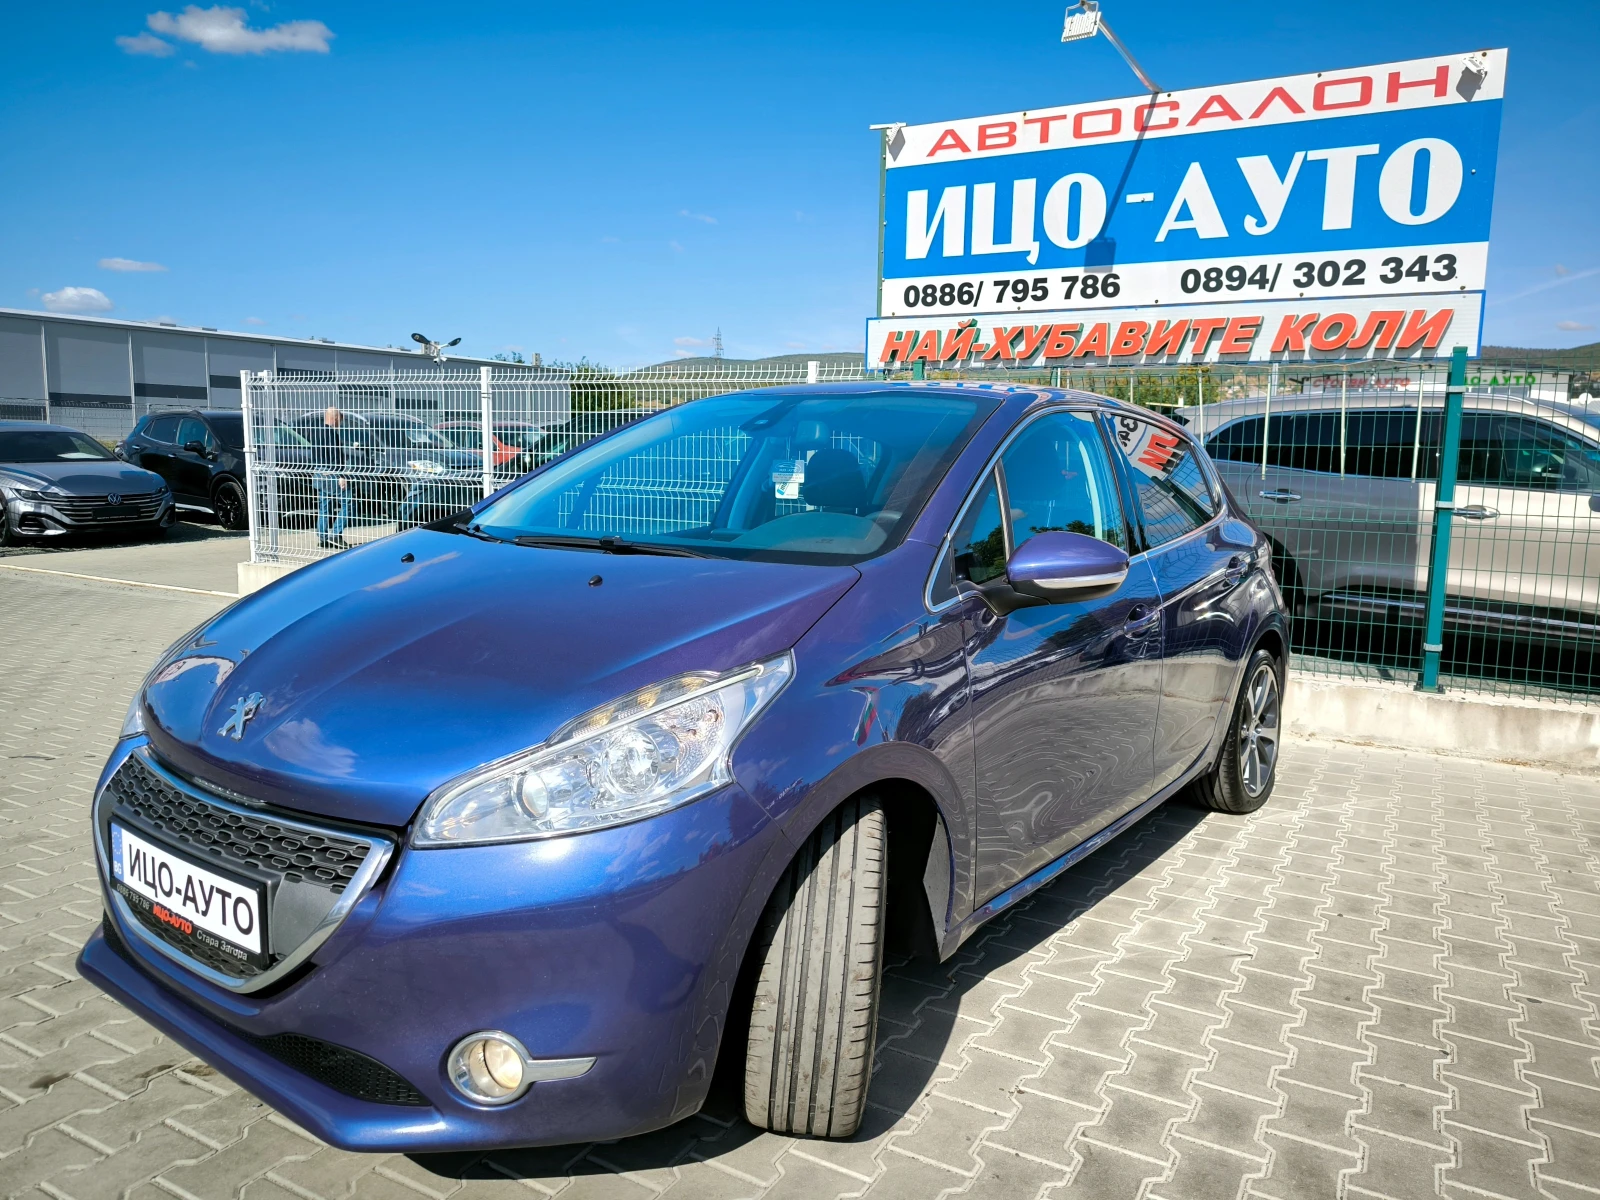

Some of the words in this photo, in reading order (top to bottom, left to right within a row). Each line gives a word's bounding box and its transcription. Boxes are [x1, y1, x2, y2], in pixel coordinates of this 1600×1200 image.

[926, 65, 1450, 157] АВТОСАЛОН
[905, 138, 1463, 265] ИЦО-АУТО
[903, 281, 983, 308] 0886/
[993, 277, 1049, 302] 795
[1061, 273, 1121, 299] 786
[1180, 263, 1282, 294] 0894/
[1292, 259, 1366, 288] 302
[1379, 254, 1457, 283] 343
[879, 315, 1263, 362] НАЙ-ХУБАВИТЕ
[1270, 309, 1455, 352] КОЛИ
[113, 860, 122, 875] BG
[128, 843, 254, 936] ИЦО-АУТО
[152, 903, 193, 935] ИЦО-АУТО
[196, 930, 219, 948] Стара
[220, 941, 248, 961] Загора
